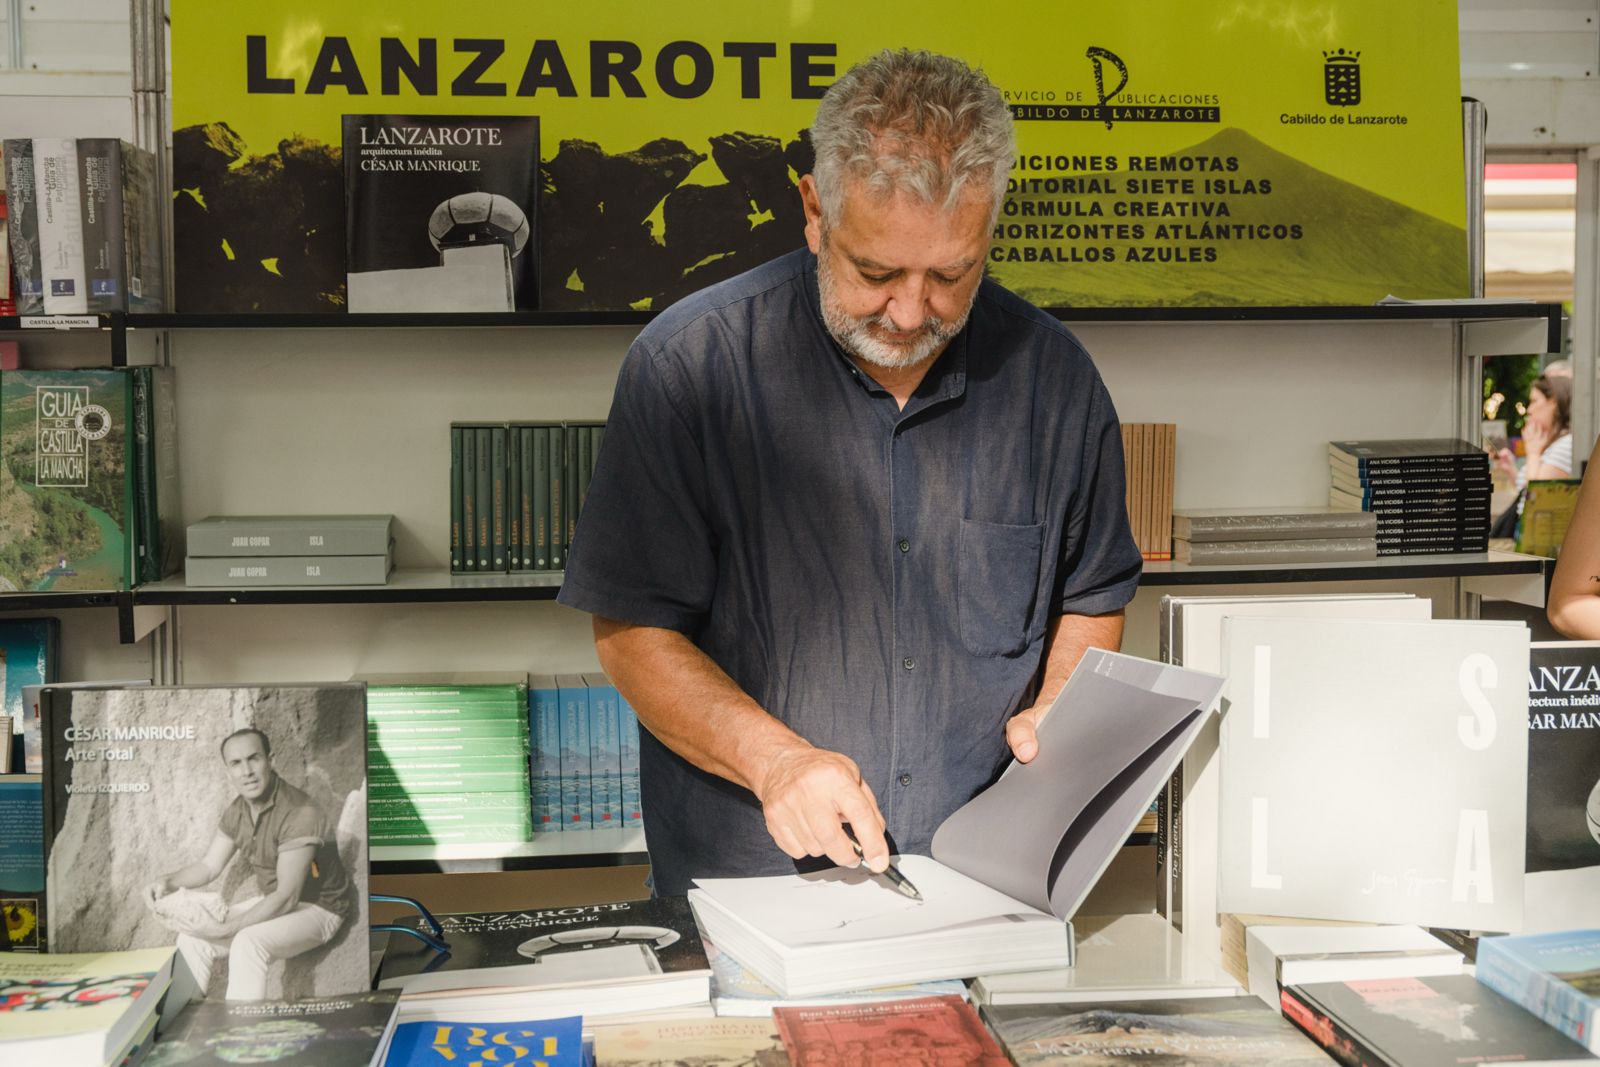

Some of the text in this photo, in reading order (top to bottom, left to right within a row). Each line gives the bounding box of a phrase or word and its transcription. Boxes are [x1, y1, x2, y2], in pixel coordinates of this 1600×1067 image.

[246, 35, 839, 100] LANZAROTE
[1003, 91, 1083, 101] RVICIO DE
[1012, 107, 1215, 120] BILDO DE LANZAROTE
[1280, 113, 1408, 125] Cabildo de Lanzarote
[360, 127, 502, 146] LANZAROTE
[360, 147, 443, 157] arquitectura inédita
[360, 156, 481, 173] CÉSAR MANRIQUE
[1010, 155, 1239, 172] ICIONES REMOTAS
[1126, 179, 1194, 195] SIETE
[1204, 179, 1273, 196] ISLAS
[1003, 197, 1231, 218] ÓRMULA CREATIVA
[992, 220, 1304, 240] HORIZONTES ATLÁNTICOS
[989, 246, 1218, 263] CABALLOS AZULES
[41, 392, 83, 417] GUIA
[55, 420, 69, 428] DE
[40, 430, 84, 453] CASTILLA
[40, 457, 84, 479] LA MANCHA
[309, 536, 324, 546] ISLA
[306, 566, 320, 576] ISLA
[1457, 652, 1499, 751] S
[1528, 713, 1600, 730] AR MAN
[114, 725, 195, 742] MANRIQUE
[64, 746, 134, 762] Arte Total
[65, 782, 150, 795] Violeta IZQUIERDO
[1172, 811, 1180, 858] puertas
[1250, 797, 1283, 890] L
[1451, 808, 1494, 905] A
[1172, 859, 1179, 879] De
[418, 902, 632, 927] LANZAROTE
[488, 915, 599, 931] MANRIQUE
